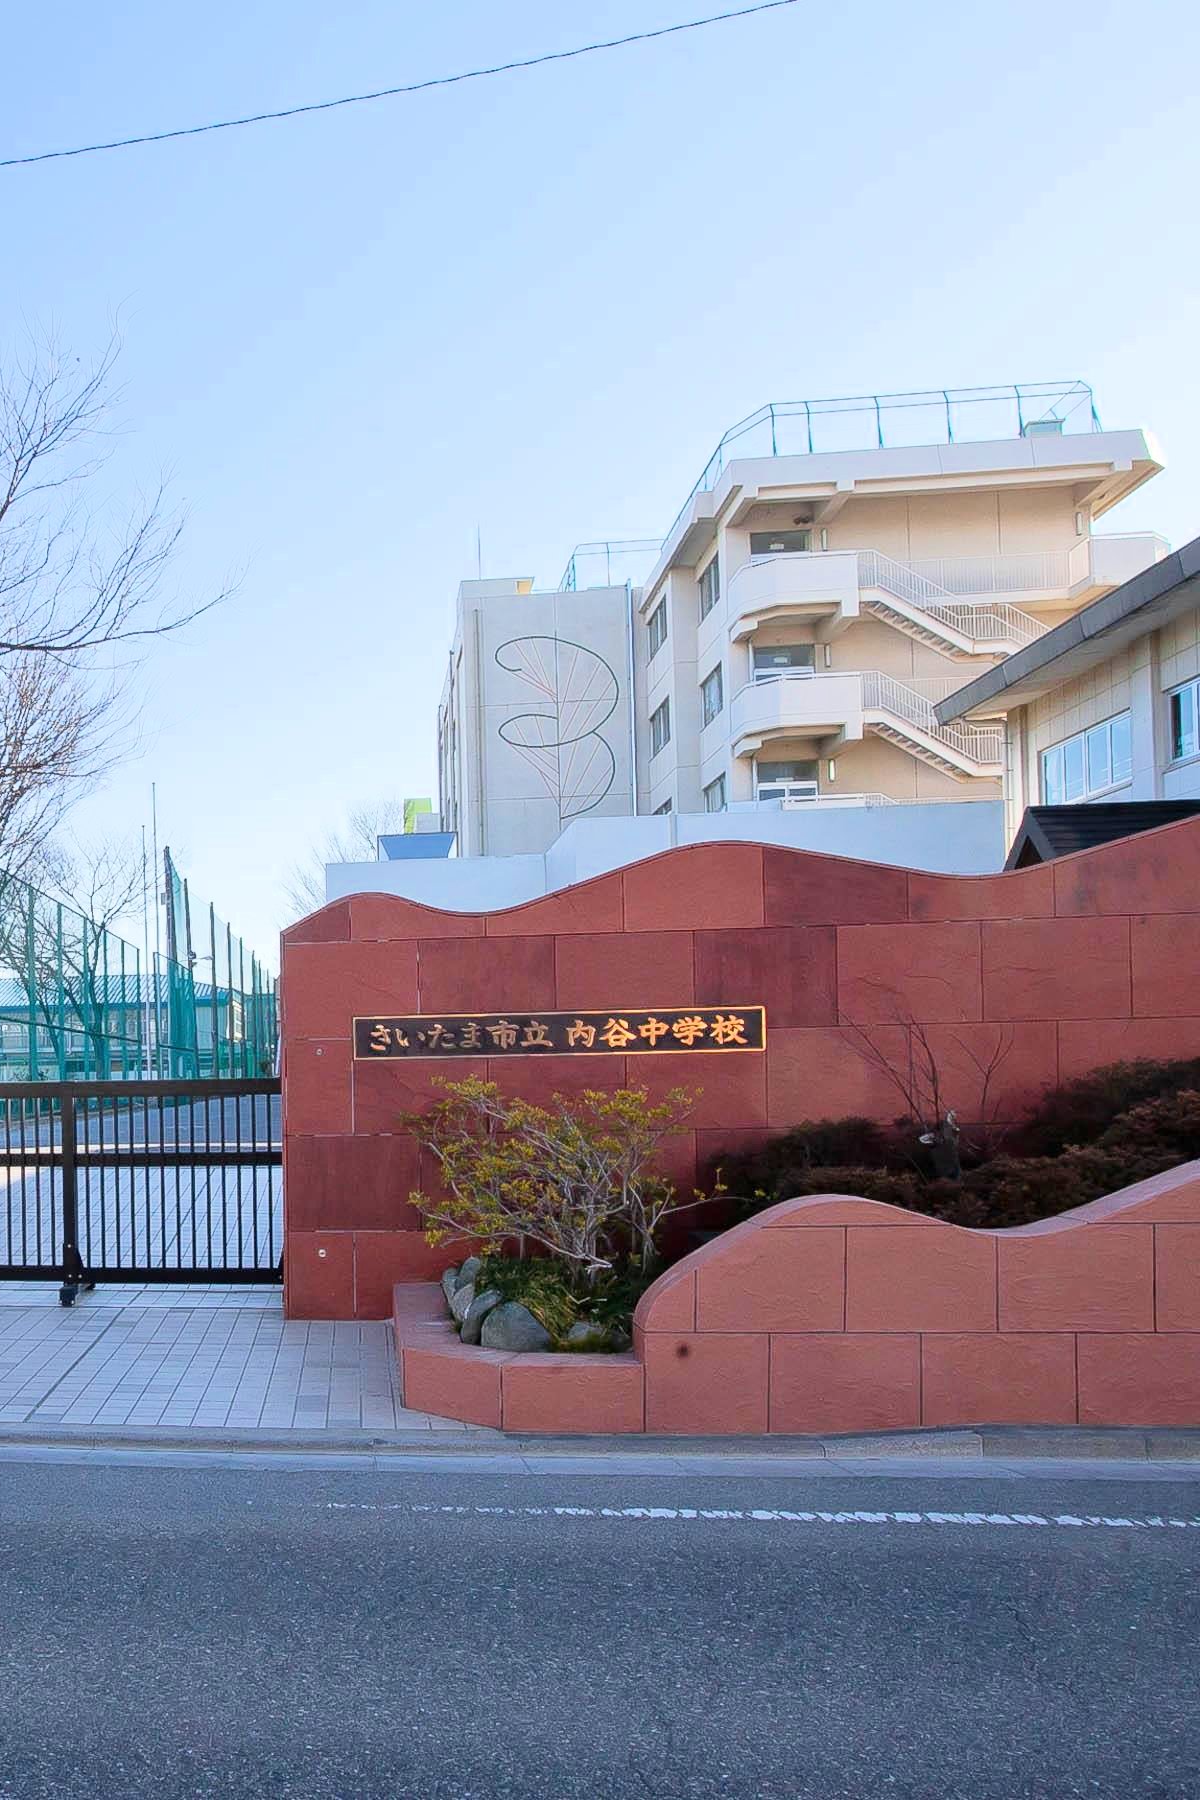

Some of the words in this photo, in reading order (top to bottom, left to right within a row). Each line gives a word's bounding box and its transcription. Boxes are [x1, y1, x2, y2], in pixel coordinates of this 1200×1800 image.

[369, 1019, 554, 1050] さいたま市立
[566, 1014, 749, 1048] 内谷中学校
